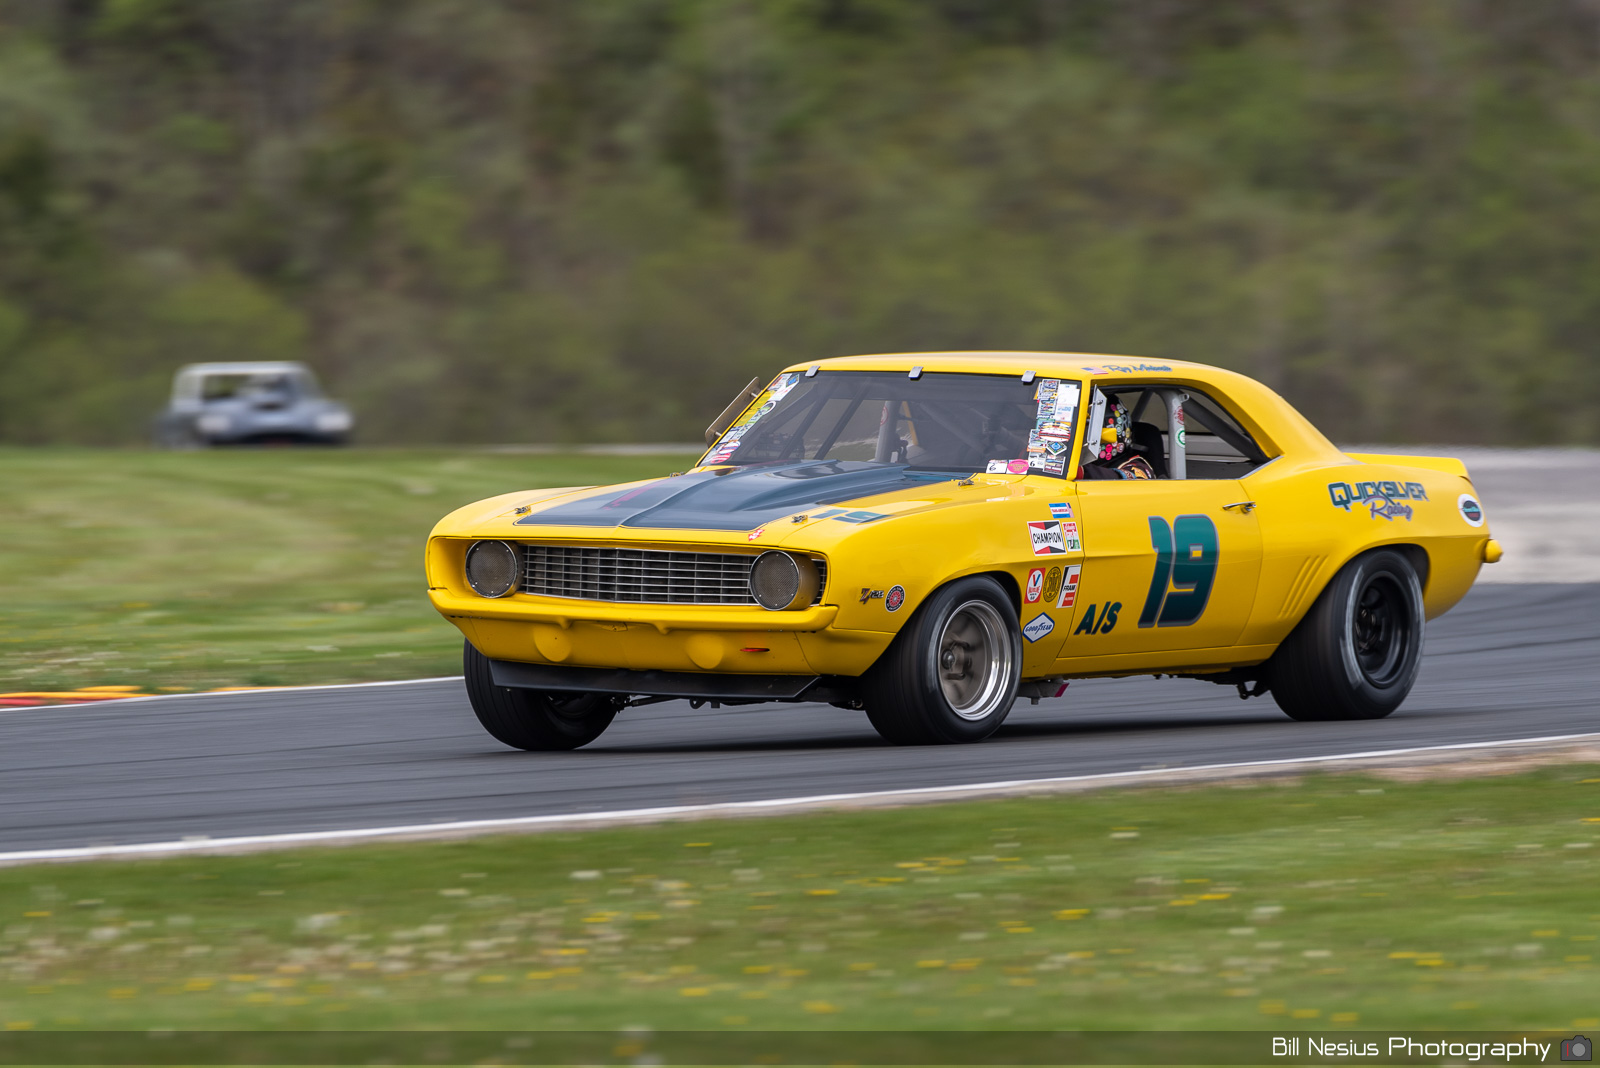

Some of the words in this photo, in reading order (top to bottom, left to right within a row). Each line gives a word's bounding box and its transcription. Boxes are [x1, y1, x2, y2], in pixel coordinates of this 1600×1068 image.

[1328, 481, 1430, 512] QUICKSILVER
[1362, 496, 1413, 521] Racing
[809, 509, 893, 523] 19
[1033, 532, 1061, 544] CHAMPION
[1138, 514, 1220, 628] 19
[1073, 601, 1122, 635] A/S
